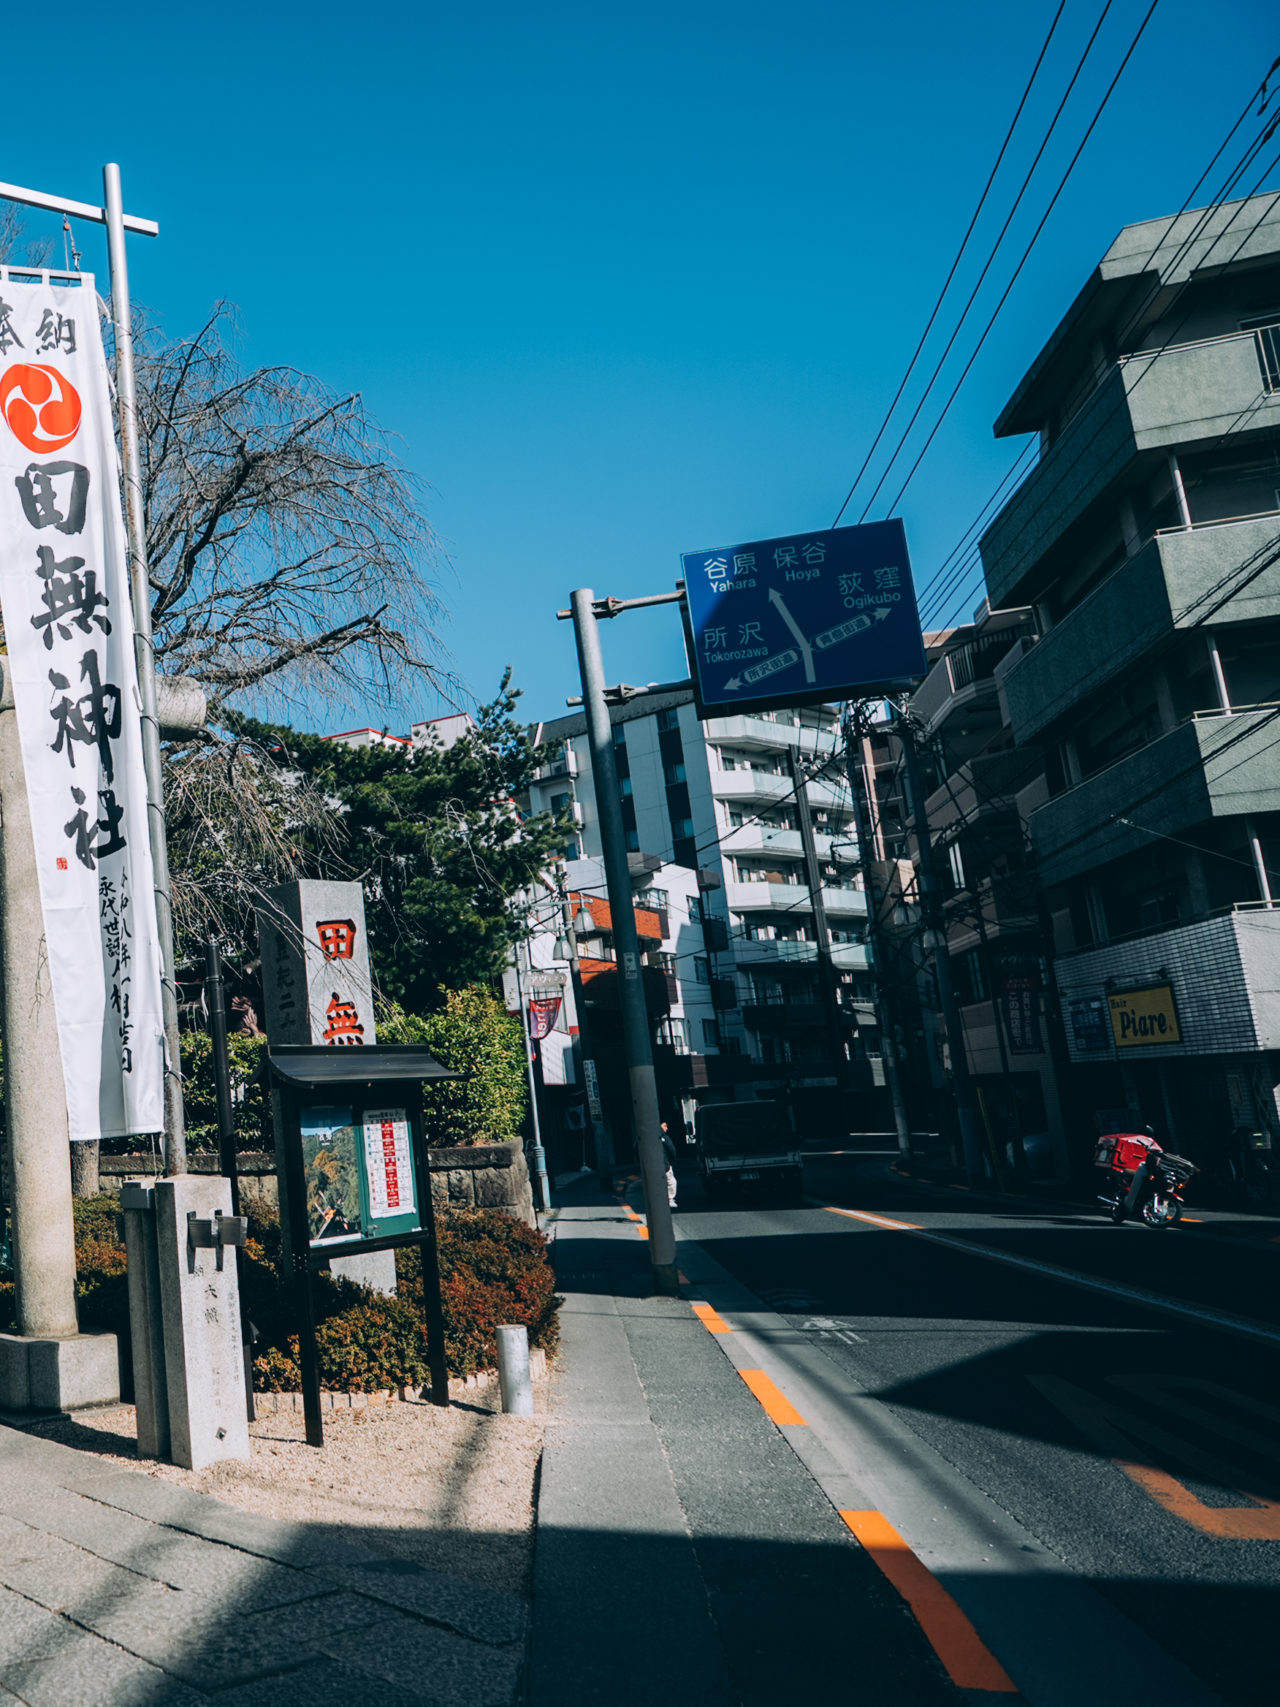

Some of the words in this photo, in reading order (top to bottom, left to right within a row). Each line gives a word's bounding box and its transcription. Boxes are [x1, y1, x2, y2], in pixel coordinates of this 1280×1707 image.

[704, 553, 758, 580] 谷原
[773, 542, 827, 569] 保谷
[710, 578, 757, 593] Yahara
[785, 567, 821, 582] Hoya
[837, 566, 901, 595] 荻窪
[843, 591, 902, 609] Ogikubo
[704, 621, 765, 650] 所沢
[14, 460, 127, 870] 田無神社
[704, 646, 769, 664] Tokorozawa
[1120, 1009, 1167, 1038] Piare
